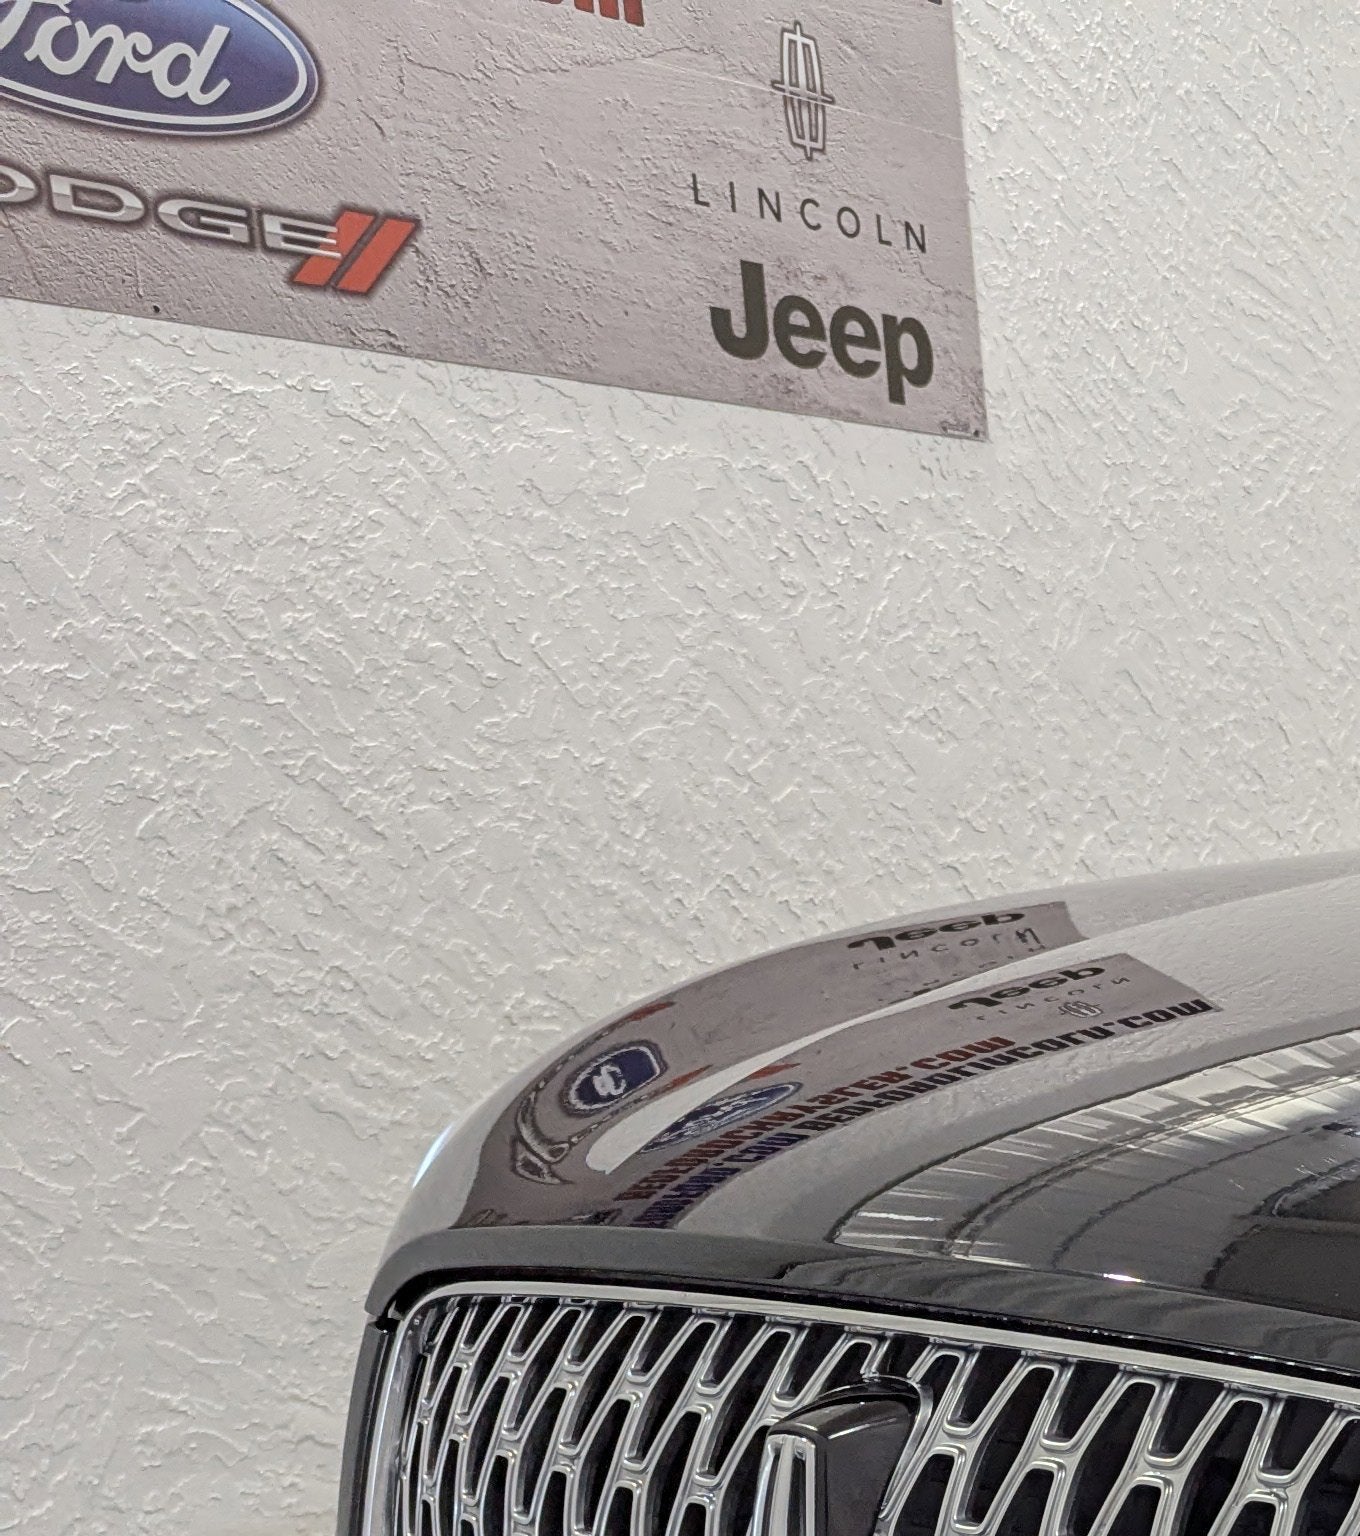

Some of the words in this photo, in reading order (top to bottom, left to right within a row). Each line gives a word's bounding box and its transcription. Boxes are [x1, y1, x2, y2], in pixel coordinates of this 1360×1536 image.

[0, 164, 343, 260] DGE
[691, 172, 928, 254] LINCOLN
[709, 259, 934, 406] Jeep
